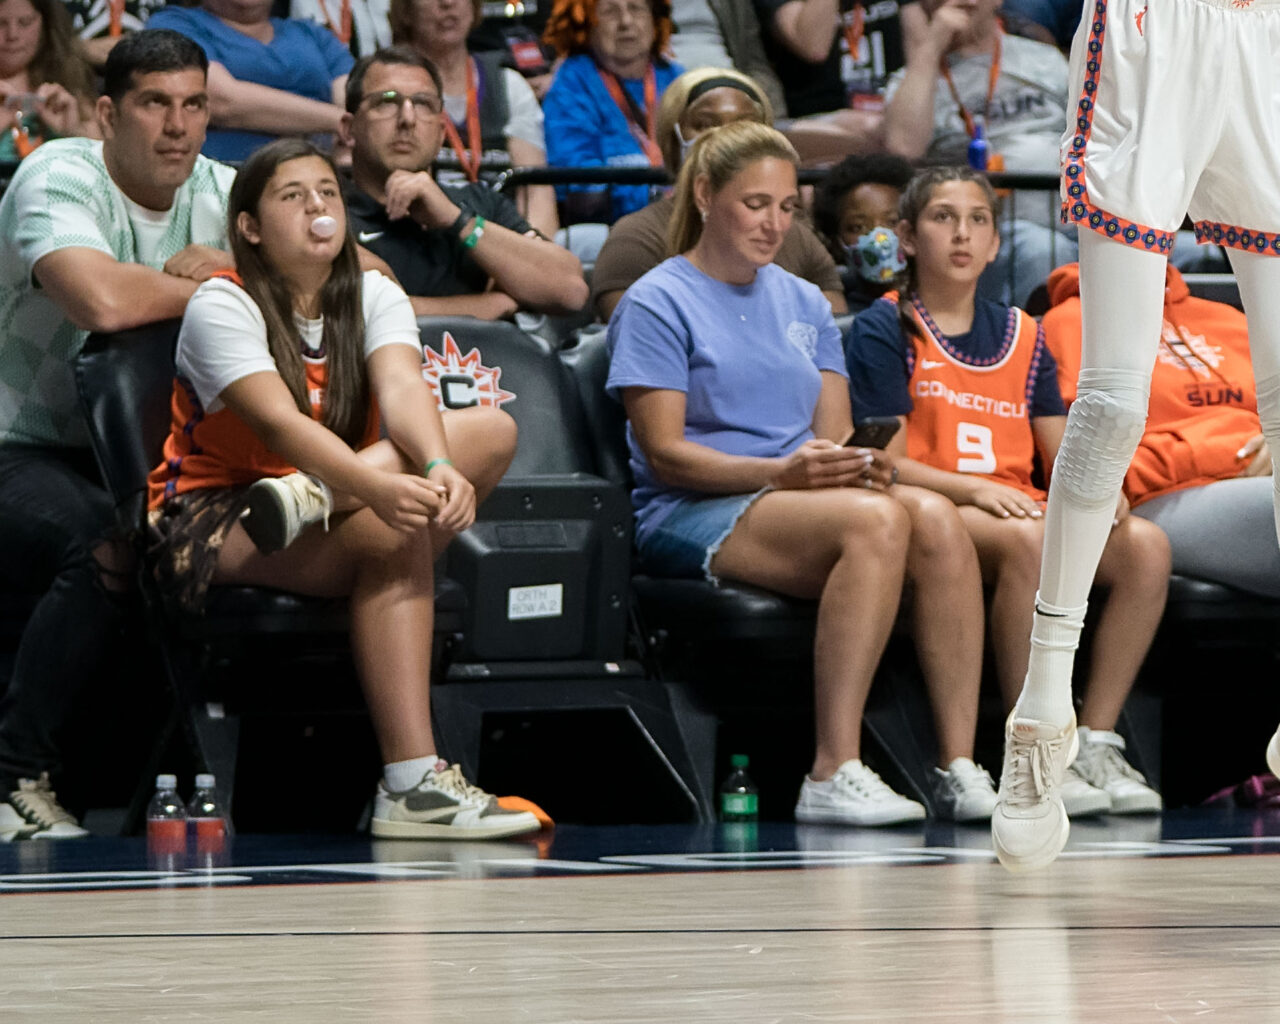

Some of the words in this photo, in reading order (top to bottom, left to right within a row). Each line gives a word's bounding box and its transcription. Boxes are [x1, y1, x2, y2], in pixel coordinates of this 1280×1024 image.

[1187, 387, 1244, 408] SUN
[957, 421, 997, 474] 9
[549, 599, 558, 611] 2
